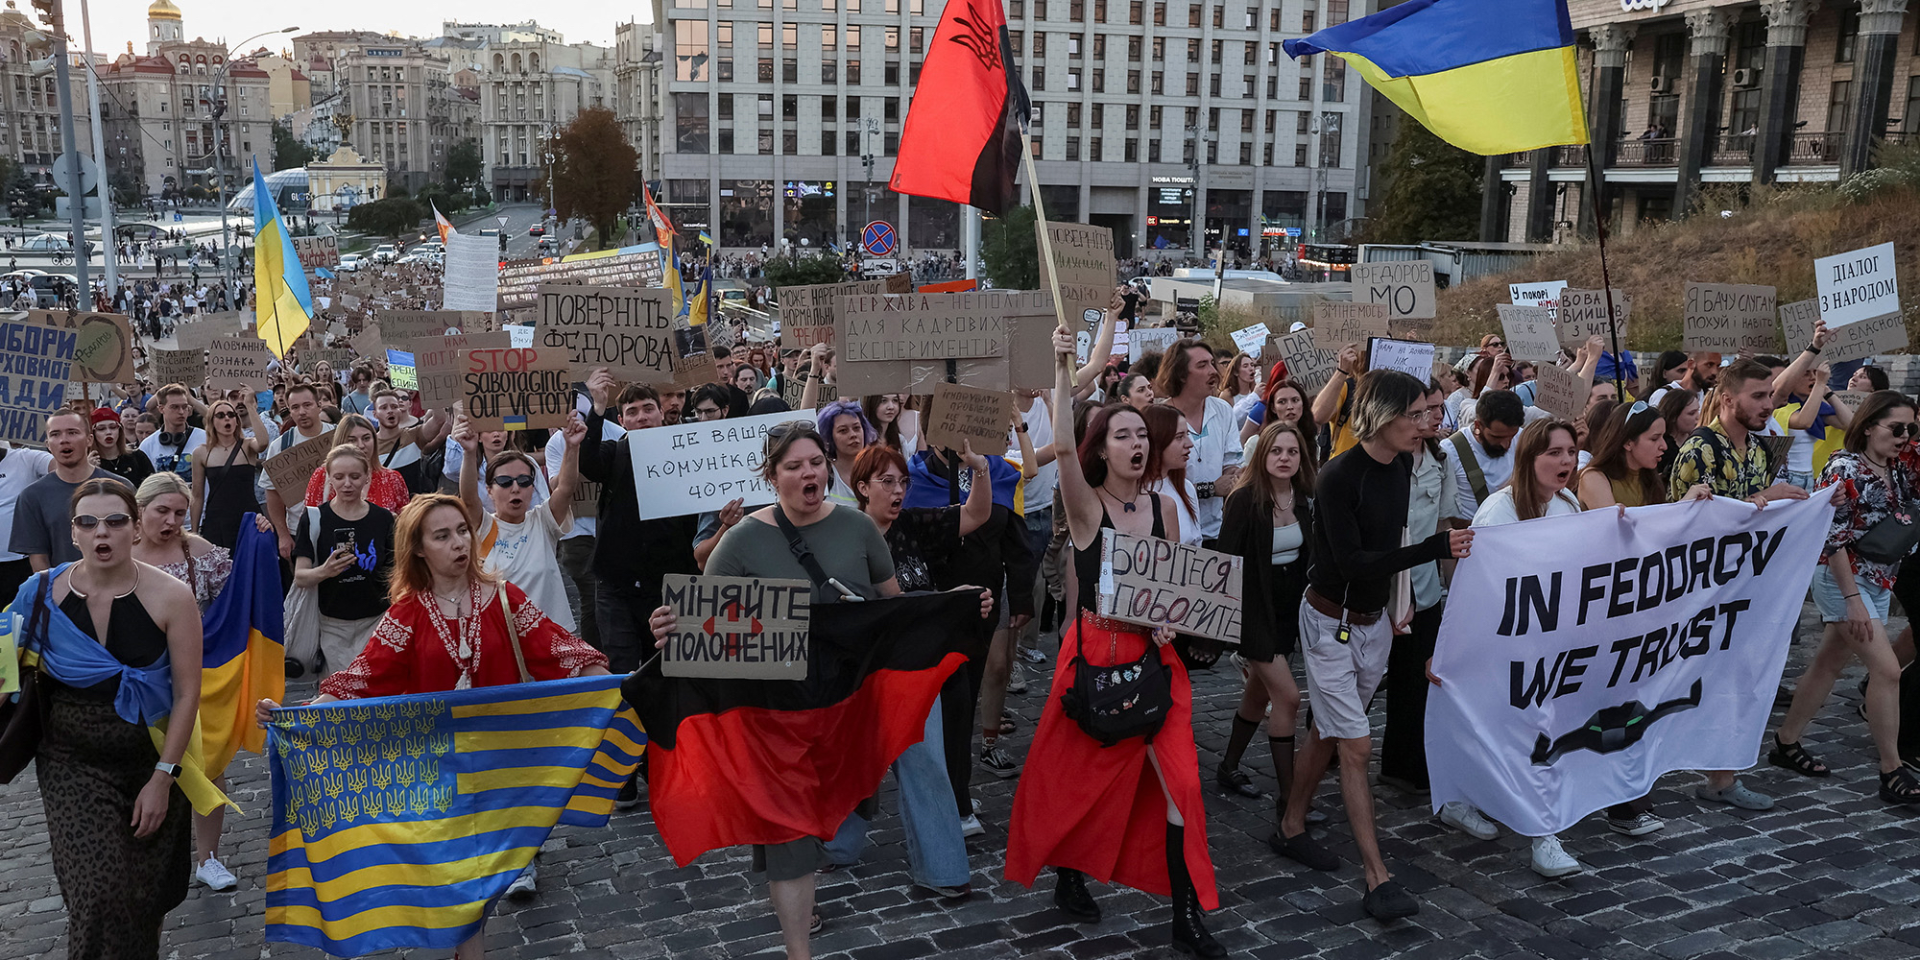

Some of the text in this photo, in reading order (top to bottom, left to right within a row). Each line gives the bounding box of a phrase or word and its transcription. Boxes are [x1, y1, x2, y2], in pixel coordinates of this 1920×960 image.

[316, 236, 336, 249] МО
[1355, 263, 1431, 284] ФЕДОРОВ
[1832, 255, 1880, 287] ДІАЛОГ
[1371, 284, 1416, 316] МО
[1511, 285, 1520, 300] У
[1562, 292, 1601, 308] ВОВА
[1687, 287, 1776, 312] Я БАЧУ СЛУГАМ
[1821, 278, 1895, 313] З НАРОДОМ
[542, 289, 669, 331] ПОВЕРНІТЬ
[846, 295, 930, 314] ДЕРЖАВА
[952, 295, 971, 310] НЕ
[1321, 302, 1383, 318] ЗМІНЕМОСЬ
[1563, 304, 1622, 323] ВИЙШВ
[847, 316, 1002, 337] ДЛЯ КАДРОВИХ
[1341, 319, 1361, 330] АБО
[1687, 314, 1730, 330] ПОХУЙ
[1847, 314, 1906, 341] ВЛАСНОГО
[211, 340, 266, 352] МОВЧАННЯ
[444, 337, 468, 348] НАМ
[543, 329, 673, 372] ФЕДОРОВА
[848, 338, 999, 360] ЕКСПЕРИМЕНТІВ
[1688, 335, 1737, 348] ТРОШКИ
[1825, 339, 1876, 360] ЖИТТЯ
[212, 355, 255, 366] ОЗНАКА
[320, 350, 338, 361] ТАМ
[468, 348, 538, 373] STOP
[211, 368, 263, 379] СЛАБКОСТІ
[420, 374, 462, 401] РЕФ
[672, 423, 769, 451] ДЕ ВАША
[265, 437, 331, 474] КОРУПЦІЯ
[646, 451, 765, 479] КОМУНІКА
[1111, 533, 1232, 594] БОРІТЕСЯ
[1497, 525, 1788, 636] IN FEDOROV
[664, 575, 811, 621] МІНЯЙТЕ
[1109, 582, 1243, 639] ПОБОРИТЕ
[663, 631, 809, 663] ПОЛОНЕНИХ
[1509, 598, 1752, 711] WE TRUST
